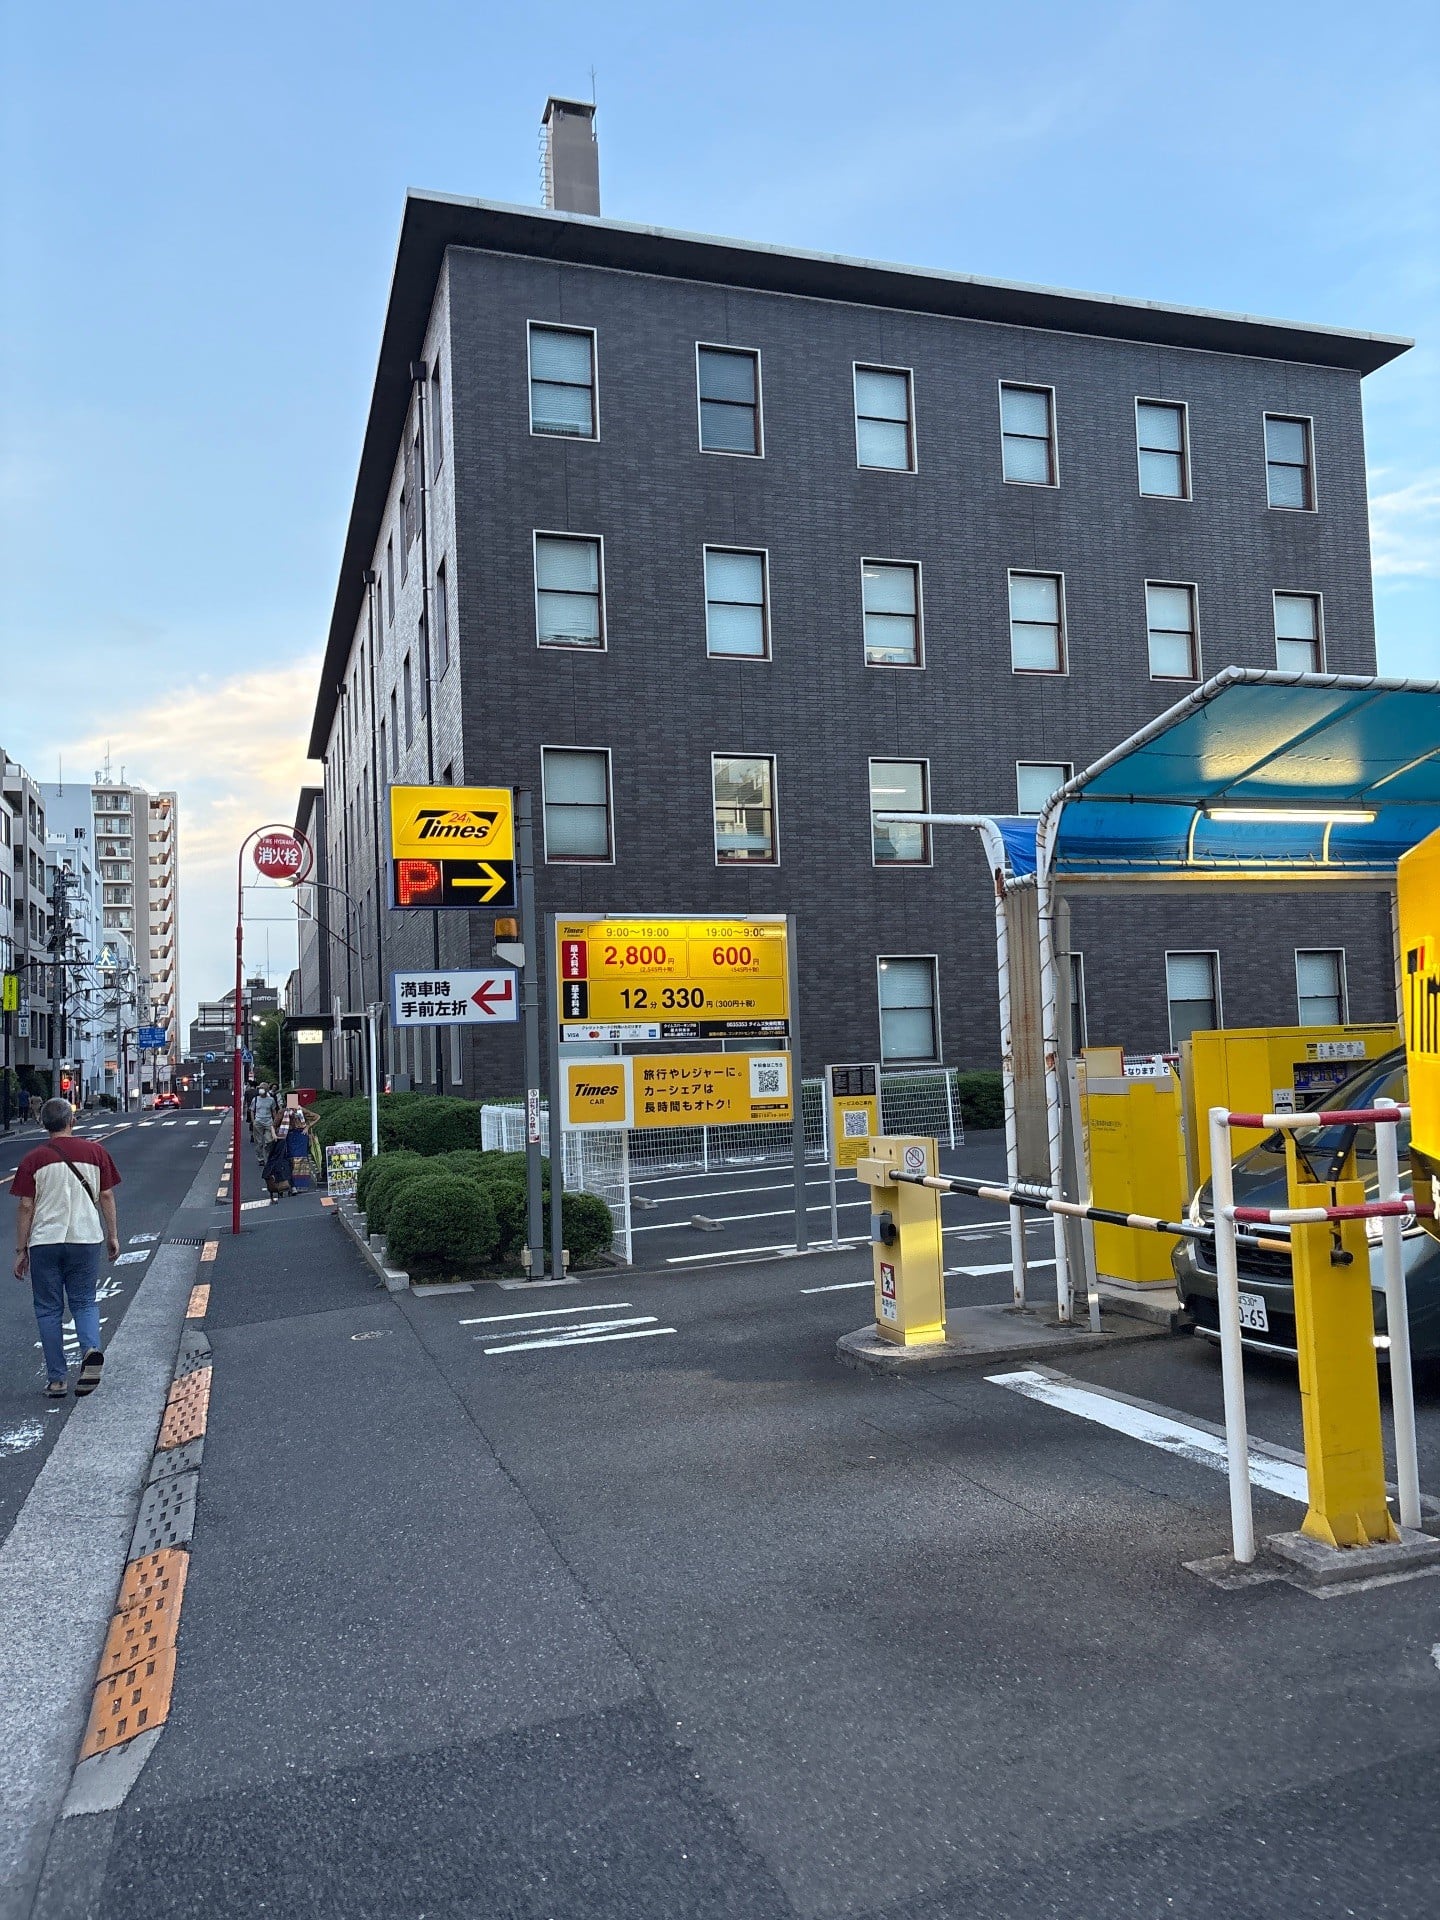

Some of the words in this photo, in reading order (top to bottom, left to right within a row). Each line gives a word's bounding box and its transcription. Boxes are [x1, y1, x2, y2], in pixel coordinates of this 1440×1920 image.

[414, 810, 490, 839] Times
[258, 846, 299, 866] 消火栓
[398, 859, 439, 905] P
[563, 926, 584, 935] Times
[570, 944, 579, 976] 最大料金
[400, 981, 450, 998] 満車時
[400, 999, 468, 1018] 手前左折
[571, 984, 580, 1016] 基本料金
[643, 1066, 743, 1081] 旅行やレジャーに。
[574, 1082, 620, 1097] Times
[643, 1084, 714, 1097] カーシェアは
[589, 1098, 605, 1106] CAR
